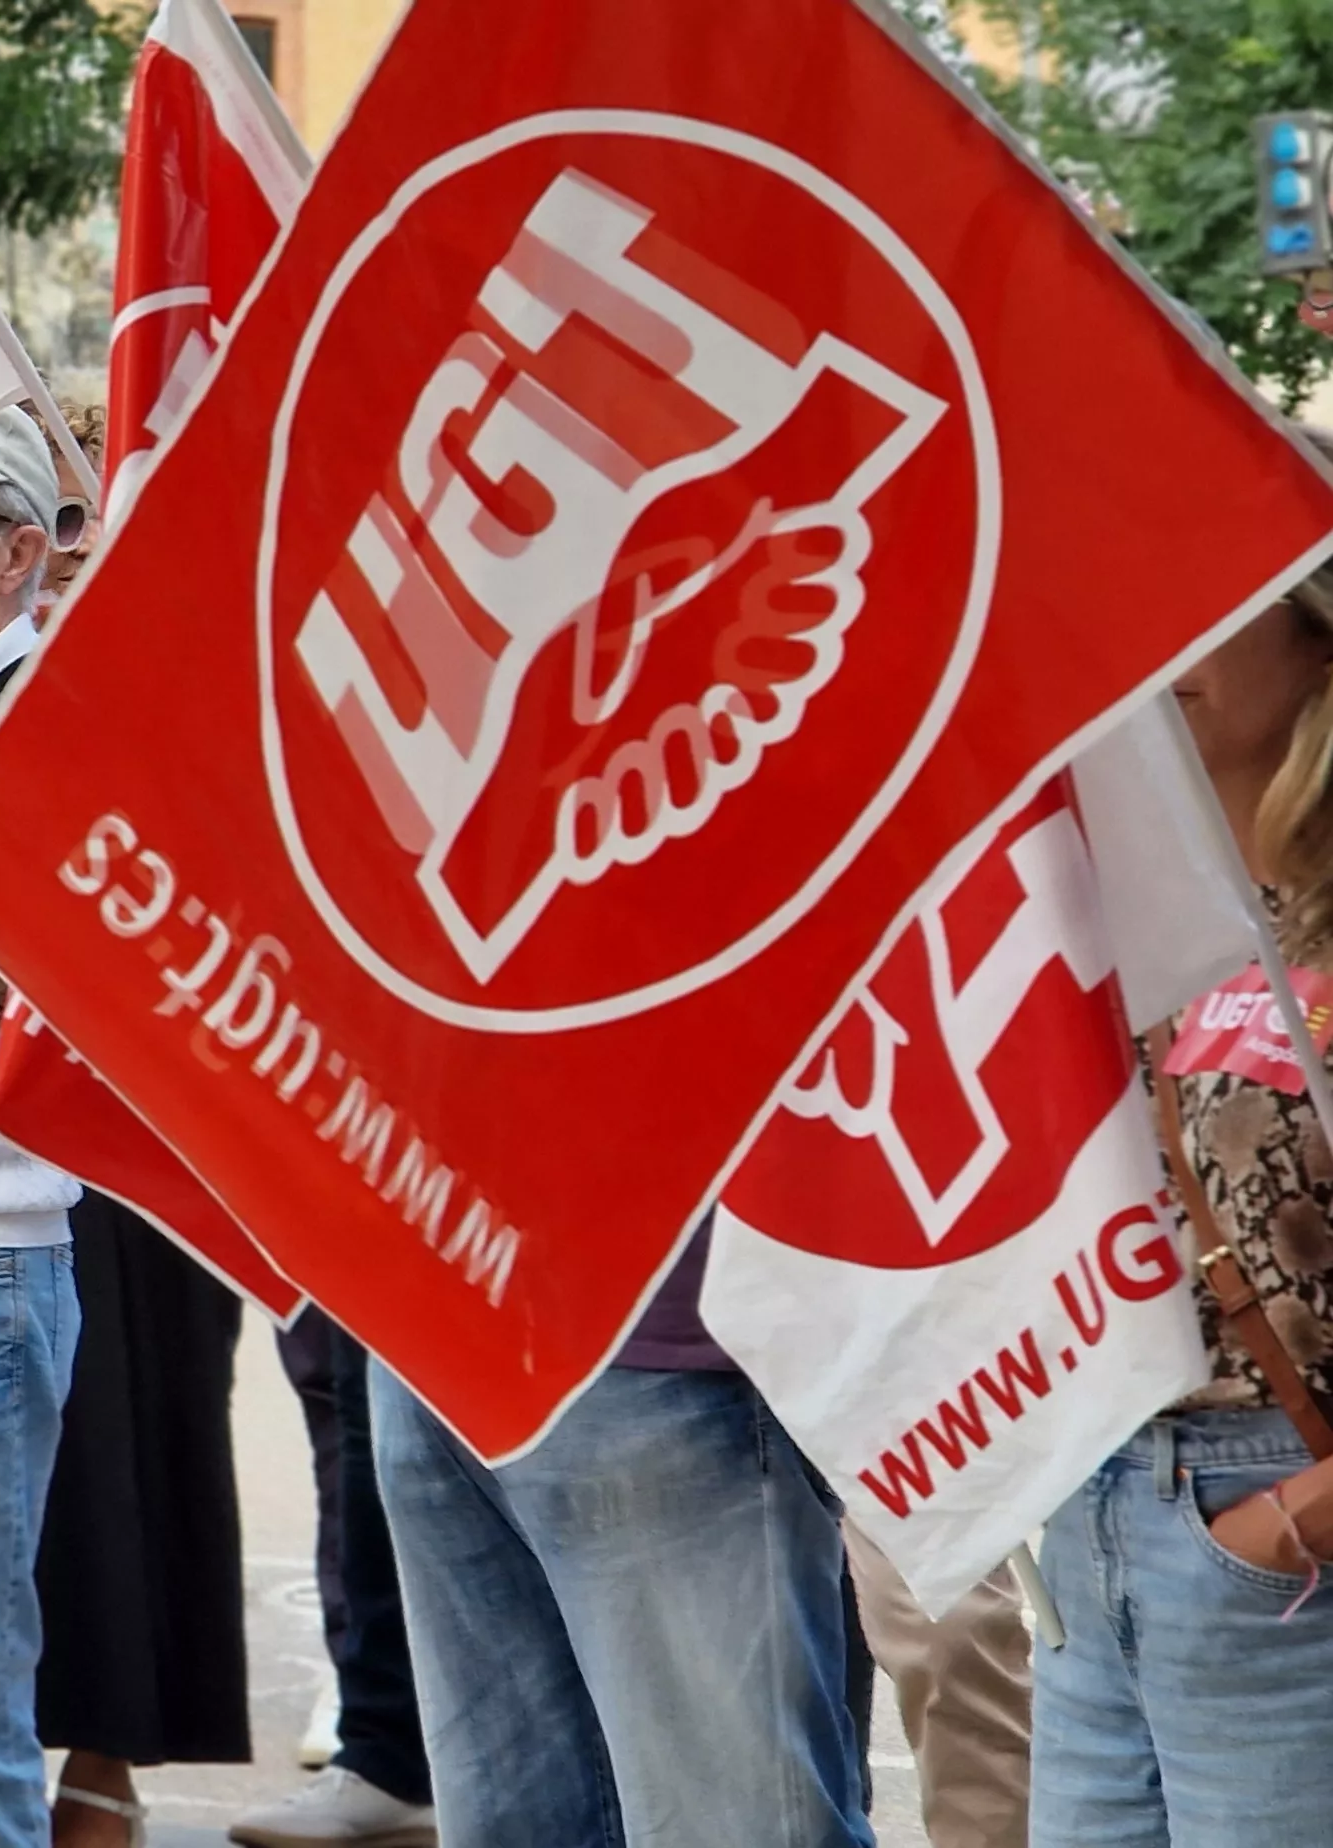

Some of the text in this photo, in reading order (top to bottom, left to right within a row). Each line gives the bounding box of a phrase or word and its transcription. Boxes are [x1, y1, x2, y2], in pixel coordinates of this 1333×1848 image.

[294, 166, 807, 856] UGT
[57, 808, 523, 1309] www.ugt.es
[1199, 991, 1275, 1031] UGT
[857, 1188, 1185, 1519] www.UG
